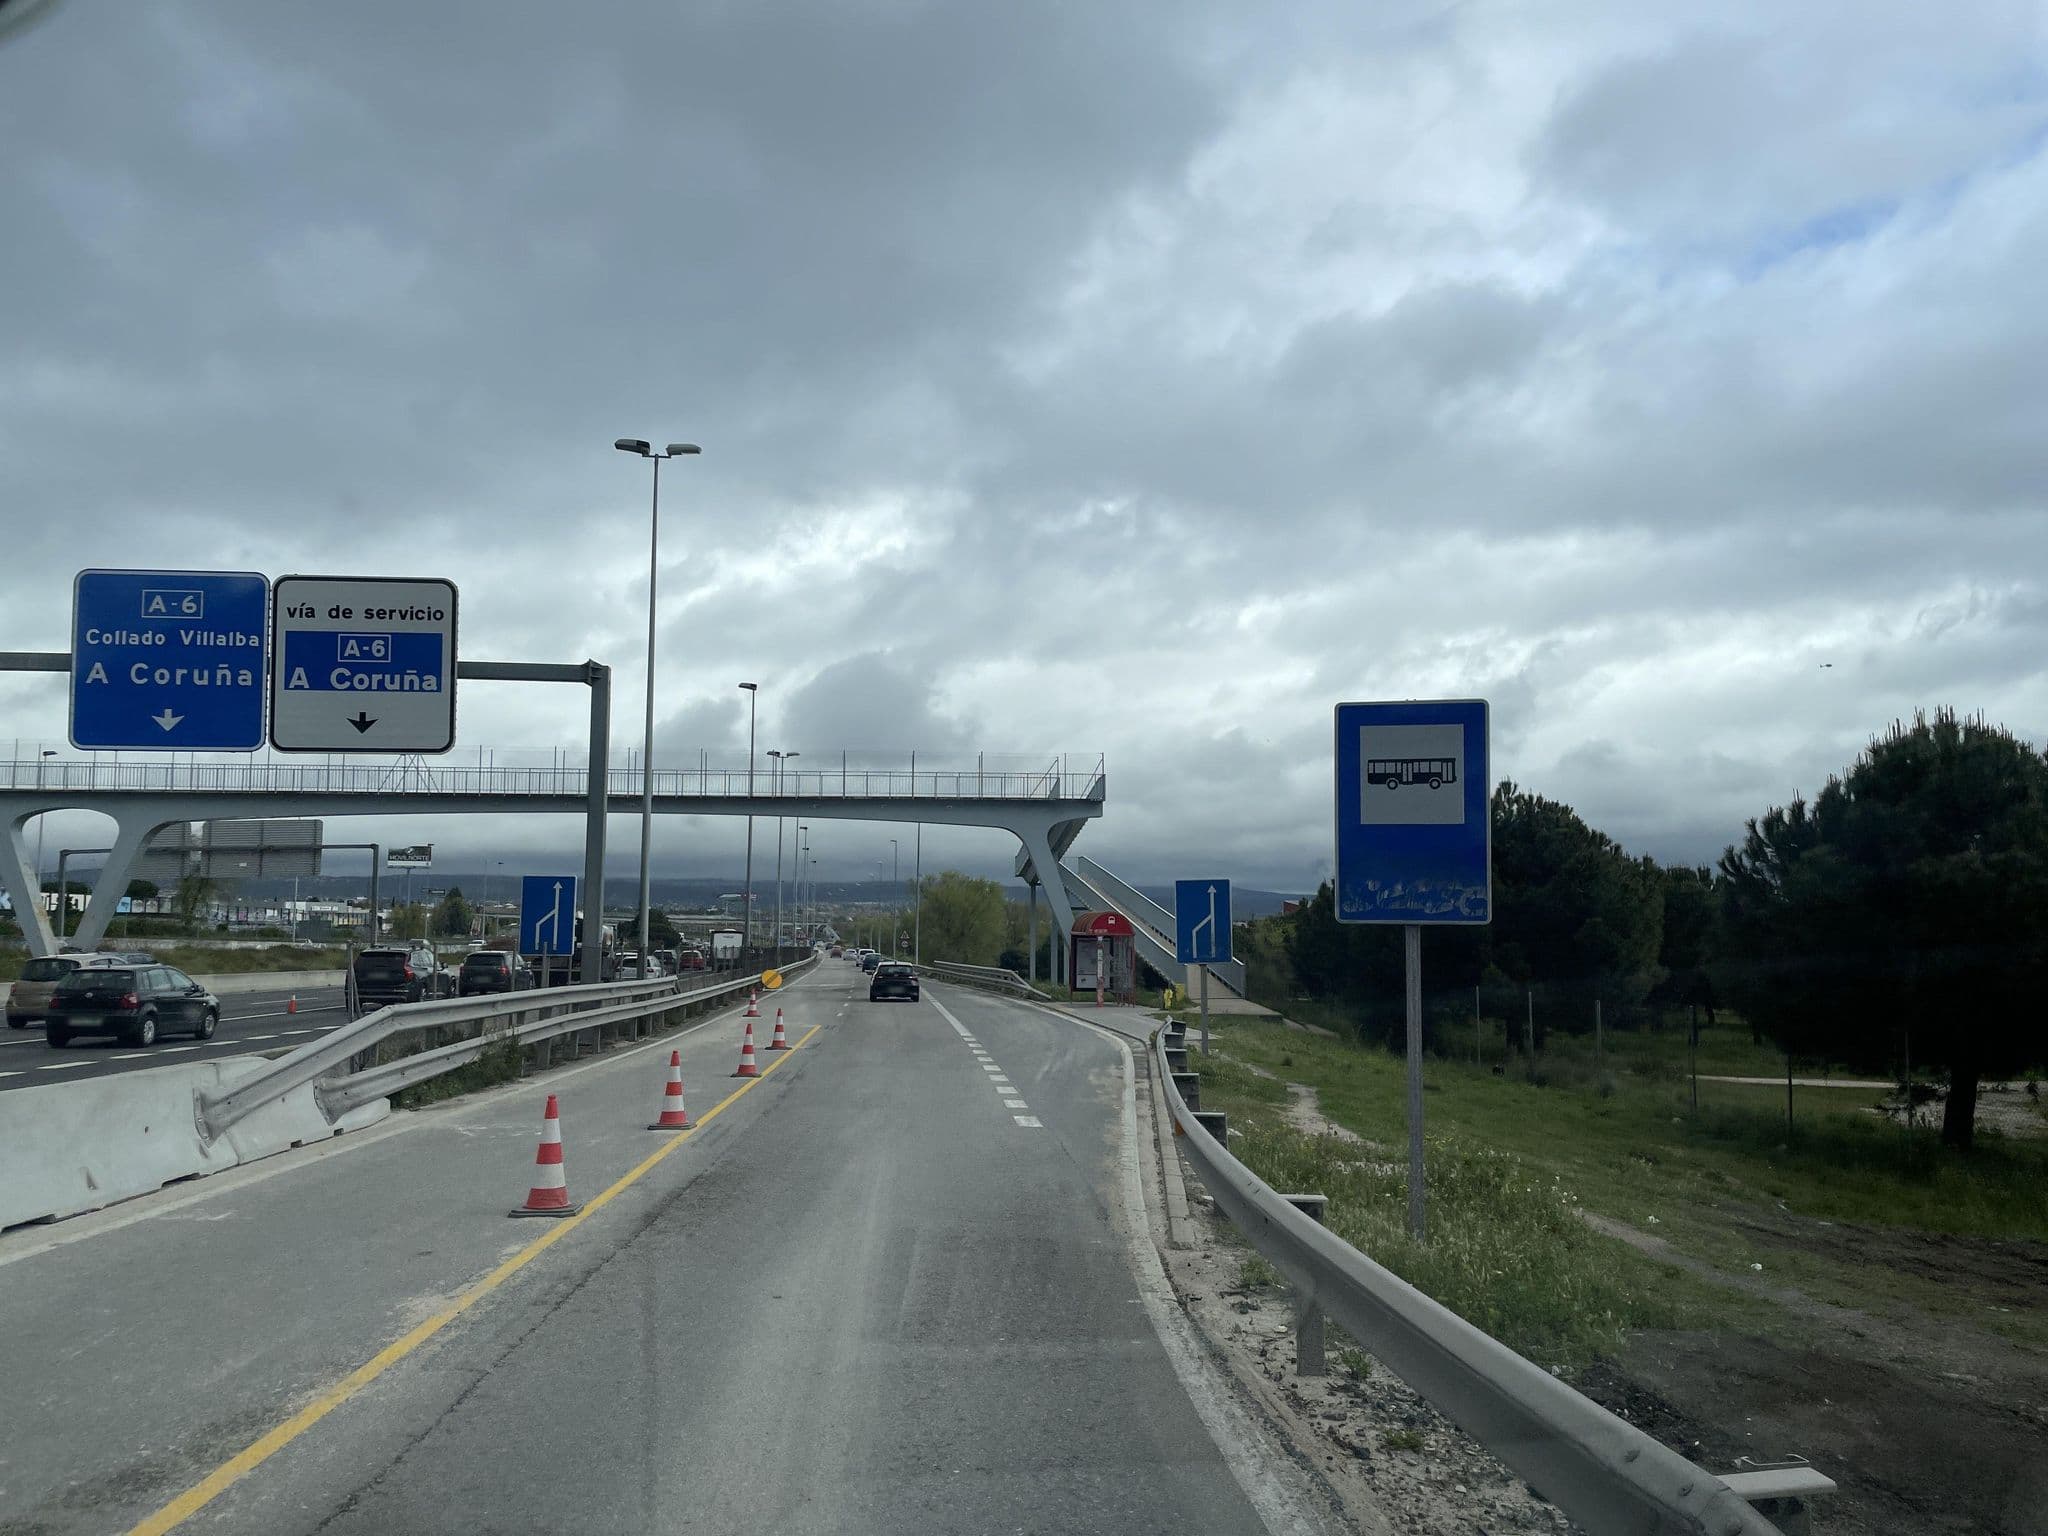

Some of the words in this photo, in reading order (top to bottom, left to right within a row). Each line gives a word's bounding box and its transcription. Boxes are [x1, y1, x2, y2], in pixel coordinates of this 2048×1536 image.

[147, 594, 198, 615] A-6
[286, 602, 316, 620] vía
[327, 604, 354, 621] de
[363, 604, 445, 622] servicio
[85, 628, 166, 646] Collado
[179, 629, 260, 648] Villalba
[343, 639, 386, 658] A-6
[85, 661, 109, 685] A
[130, 662, 253, 687] Coruña
[288, 667, 310, 689] A
[329, 667, 439, 692] Coruña
